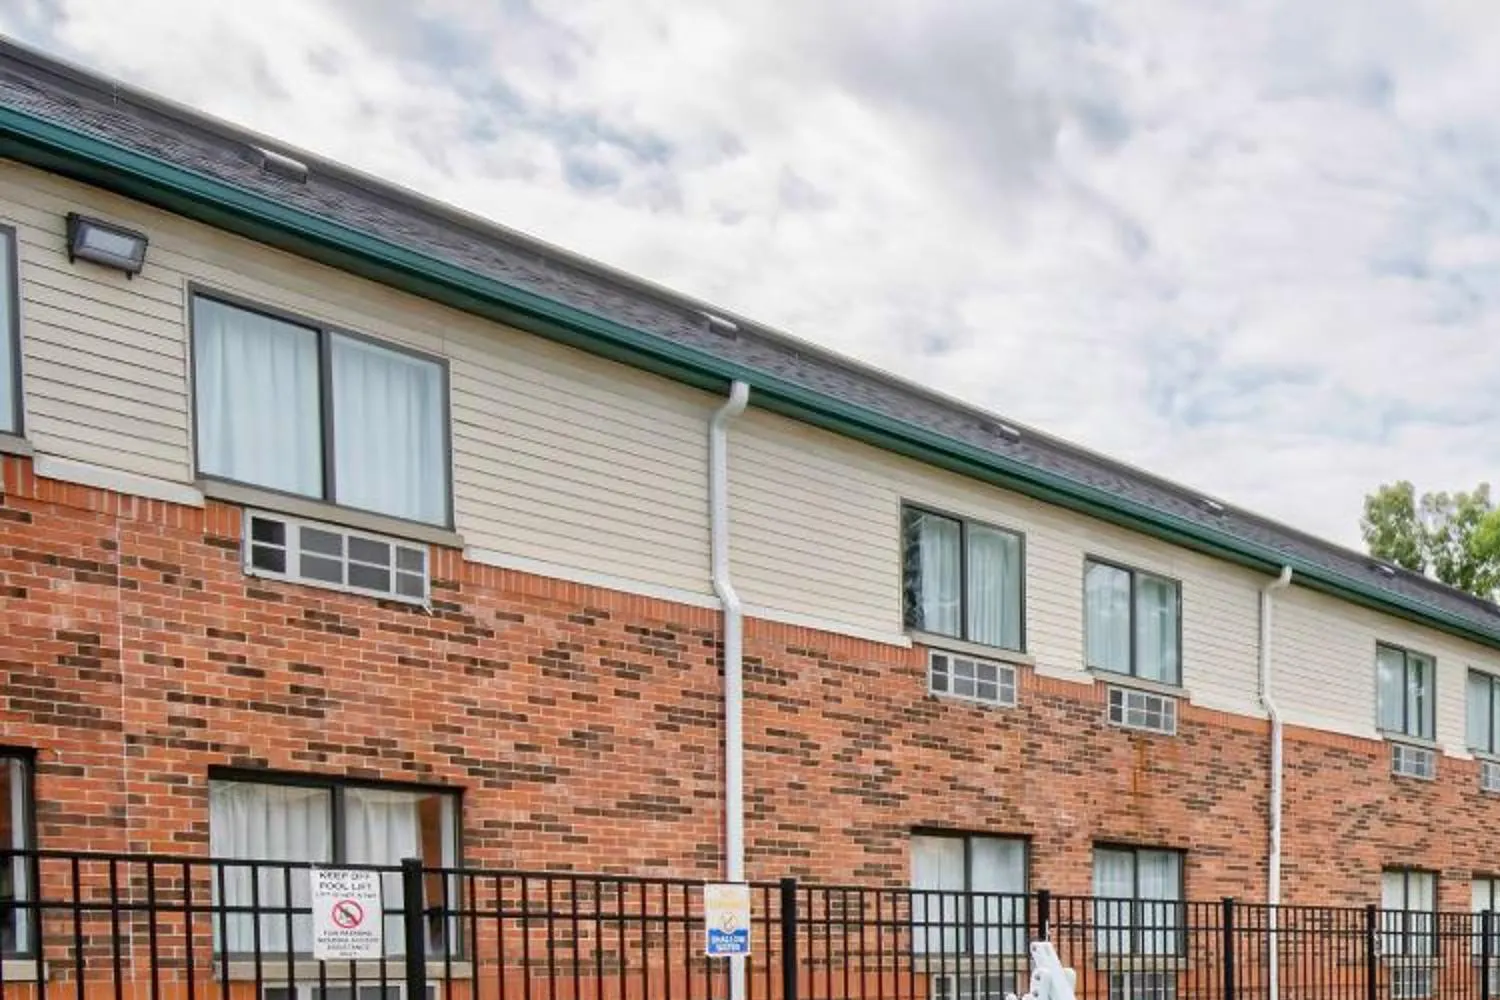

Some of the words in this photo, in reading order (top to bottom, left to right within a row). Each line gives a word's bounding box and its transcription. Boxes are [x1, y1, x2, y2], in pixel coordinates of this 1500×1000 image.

[319, 872, 348, 880] KEEP
[351, 872, 371, 881] OFF
[319, 882, 349, 890] POOL
[351, 882, 372, 891] LIFT
